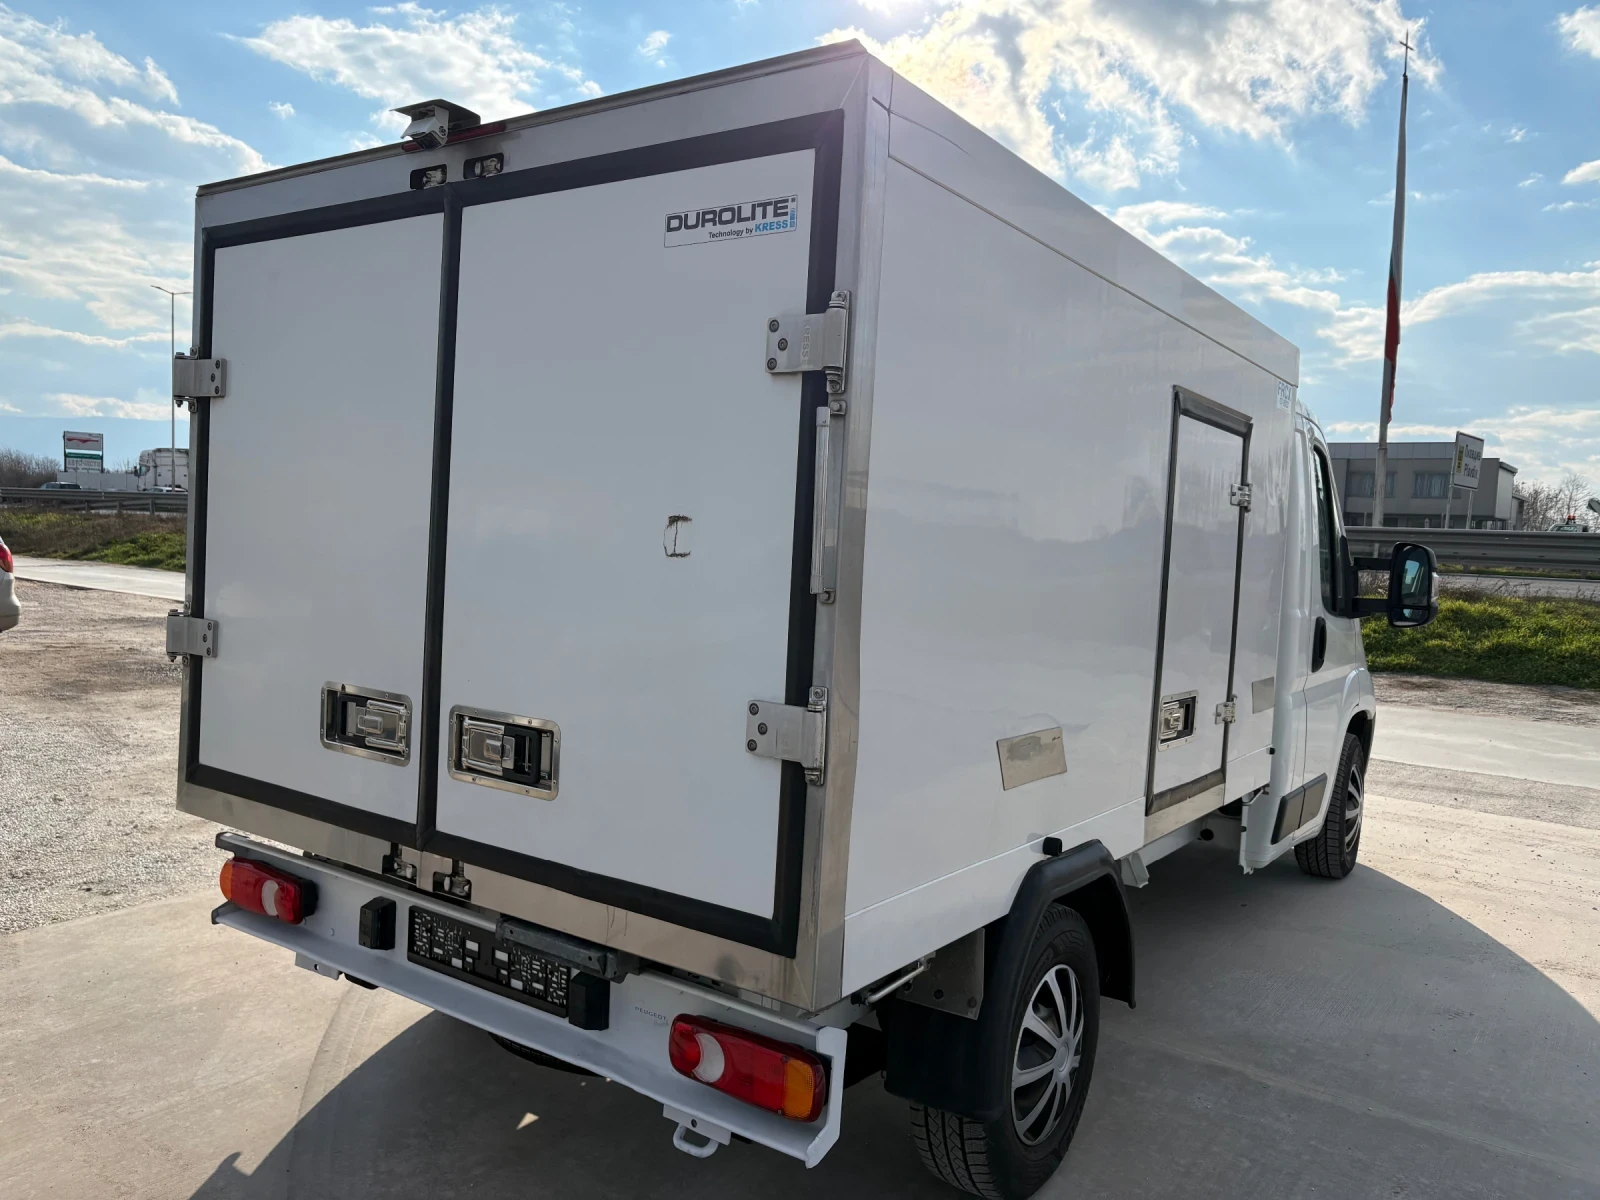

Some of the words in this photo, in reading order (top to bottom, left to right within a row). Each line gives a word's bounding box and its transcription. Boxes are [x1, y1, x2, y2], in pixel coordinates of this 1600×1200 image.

[667, 199, 789, 232] DUROLITE
[709, 228, 744, 239] Technology
[745, 227, 754, 235] by
[755, 219, 788, 232] KRESS
[634, 1006, 667, 1020] PEUGEOT
